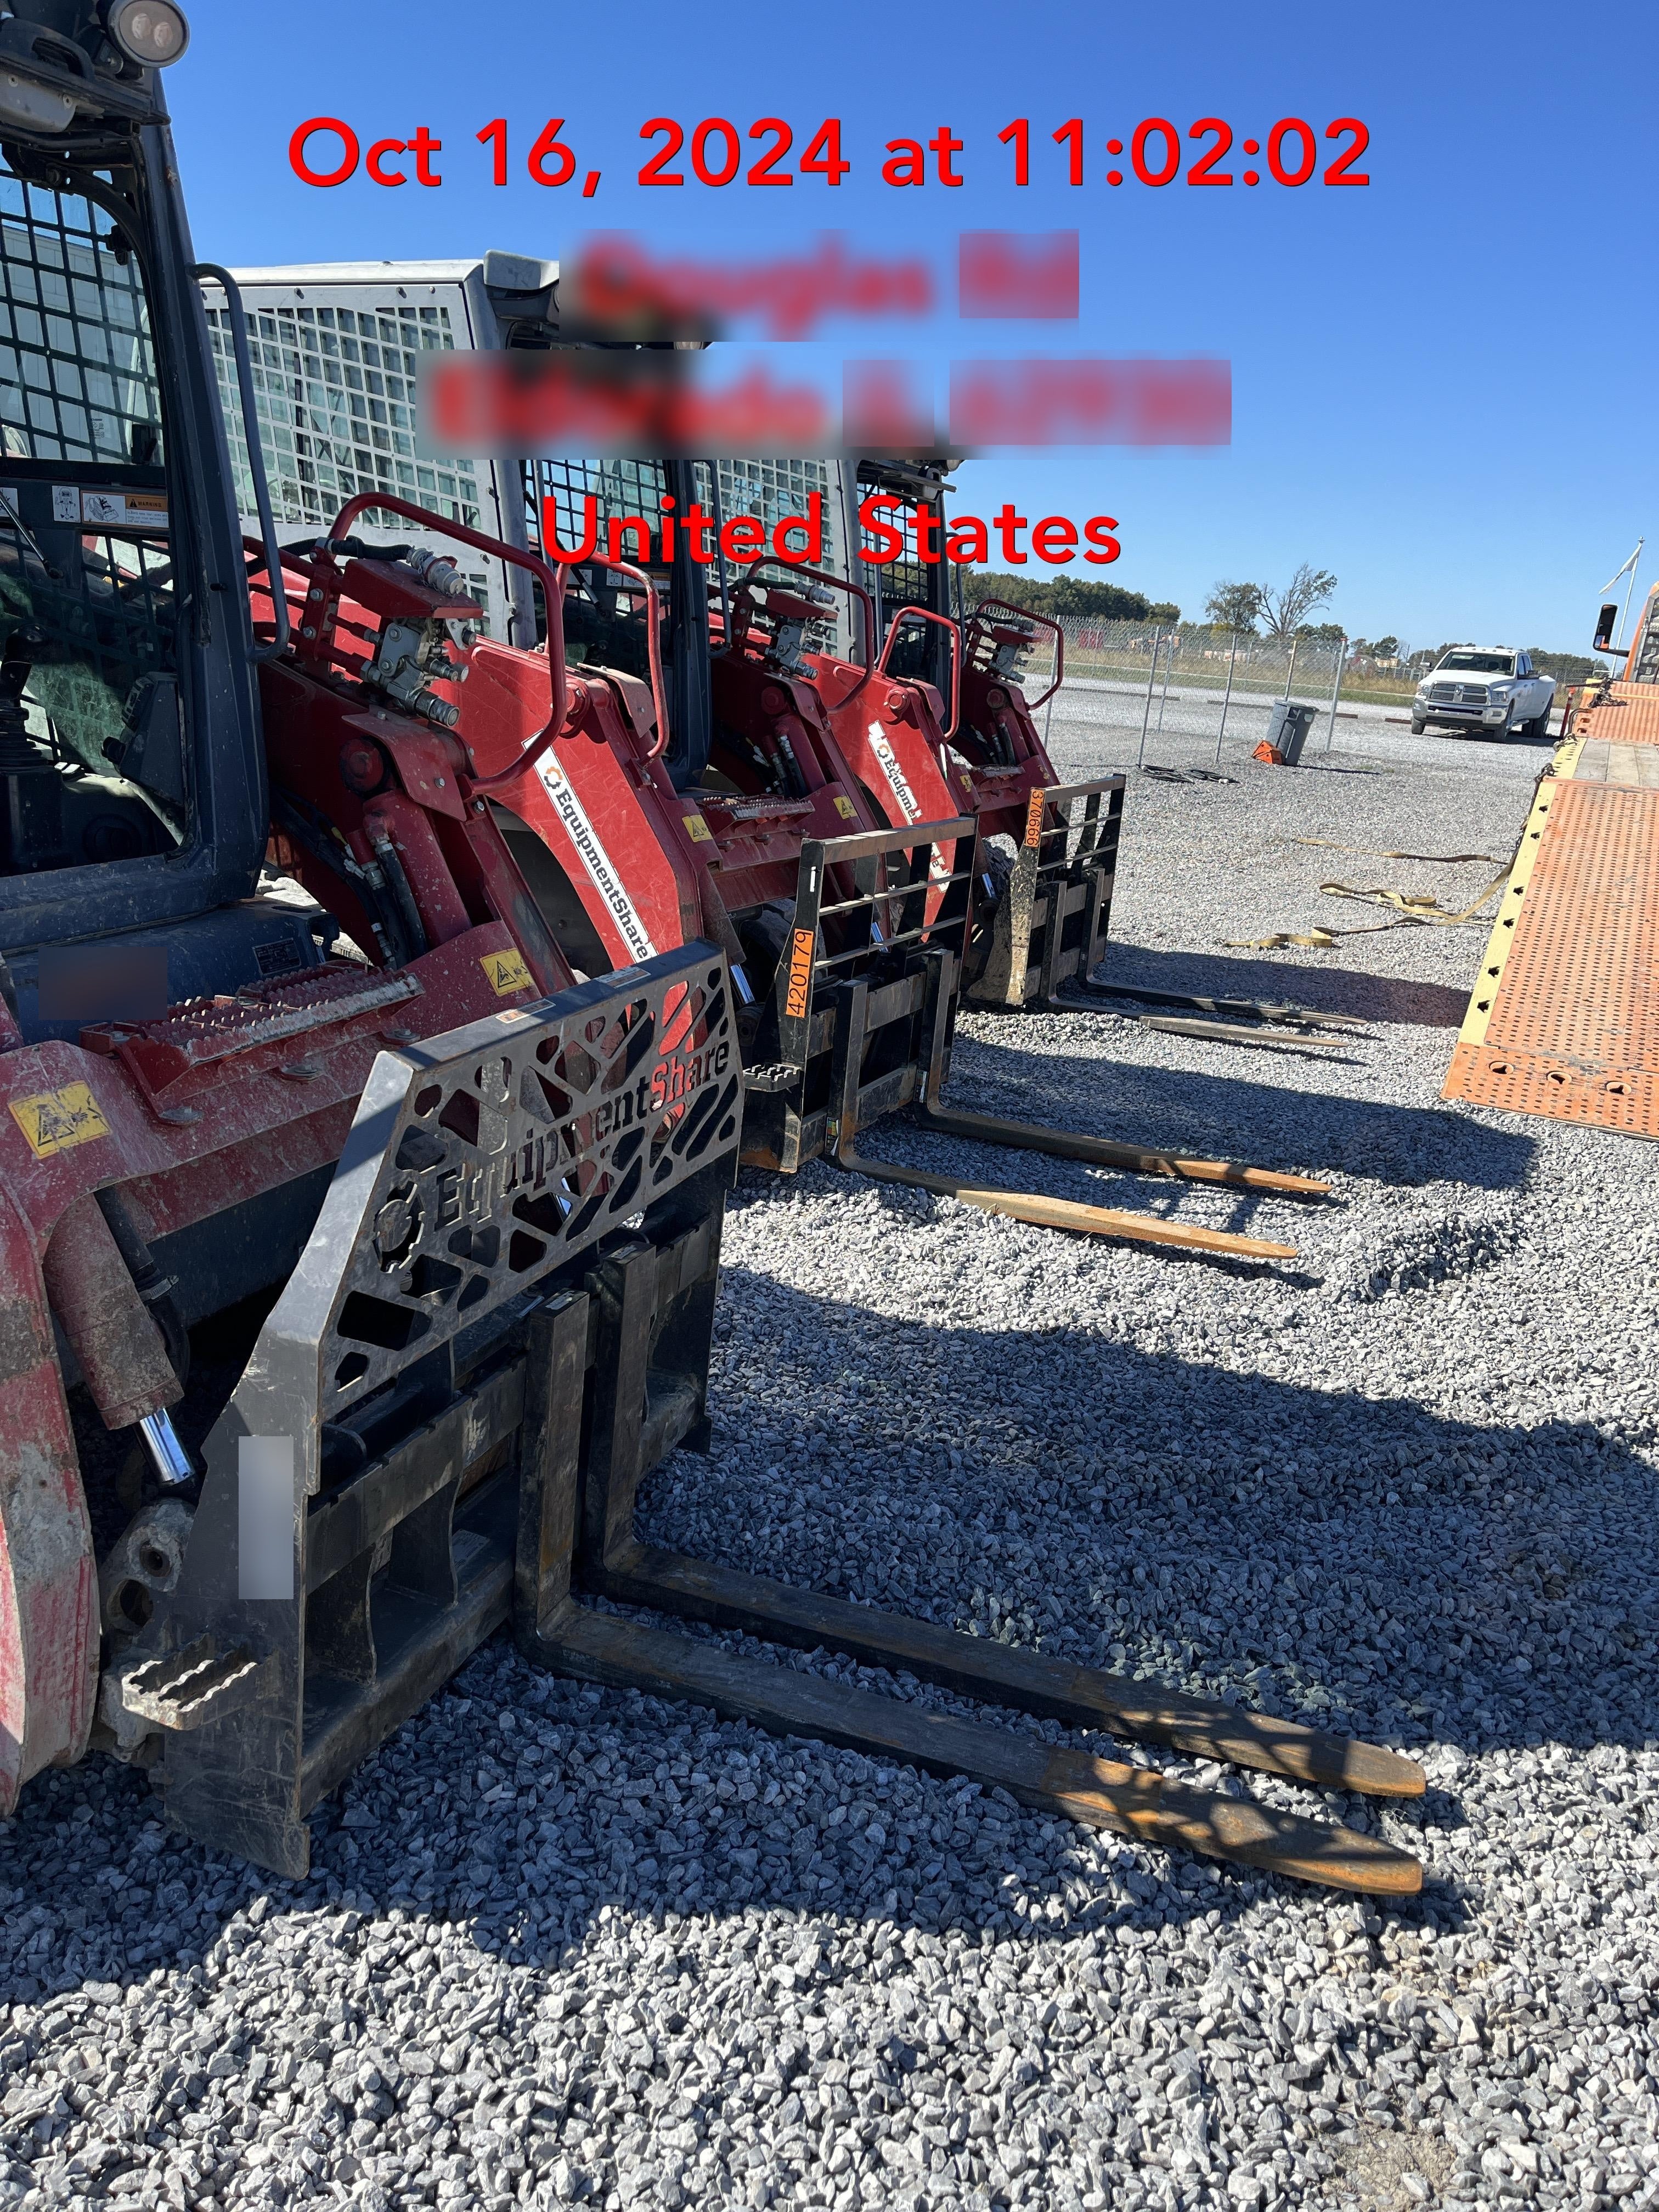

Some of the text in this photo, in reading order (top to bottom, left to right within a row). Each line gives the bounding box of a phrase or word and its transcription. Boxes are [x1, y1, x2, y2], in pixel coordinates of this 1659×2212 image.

[1026, 790, 1043, 845] 370666
[556, 788, 648, 959] EquipmentShare
[788, 931, 812, 1015] 420179
